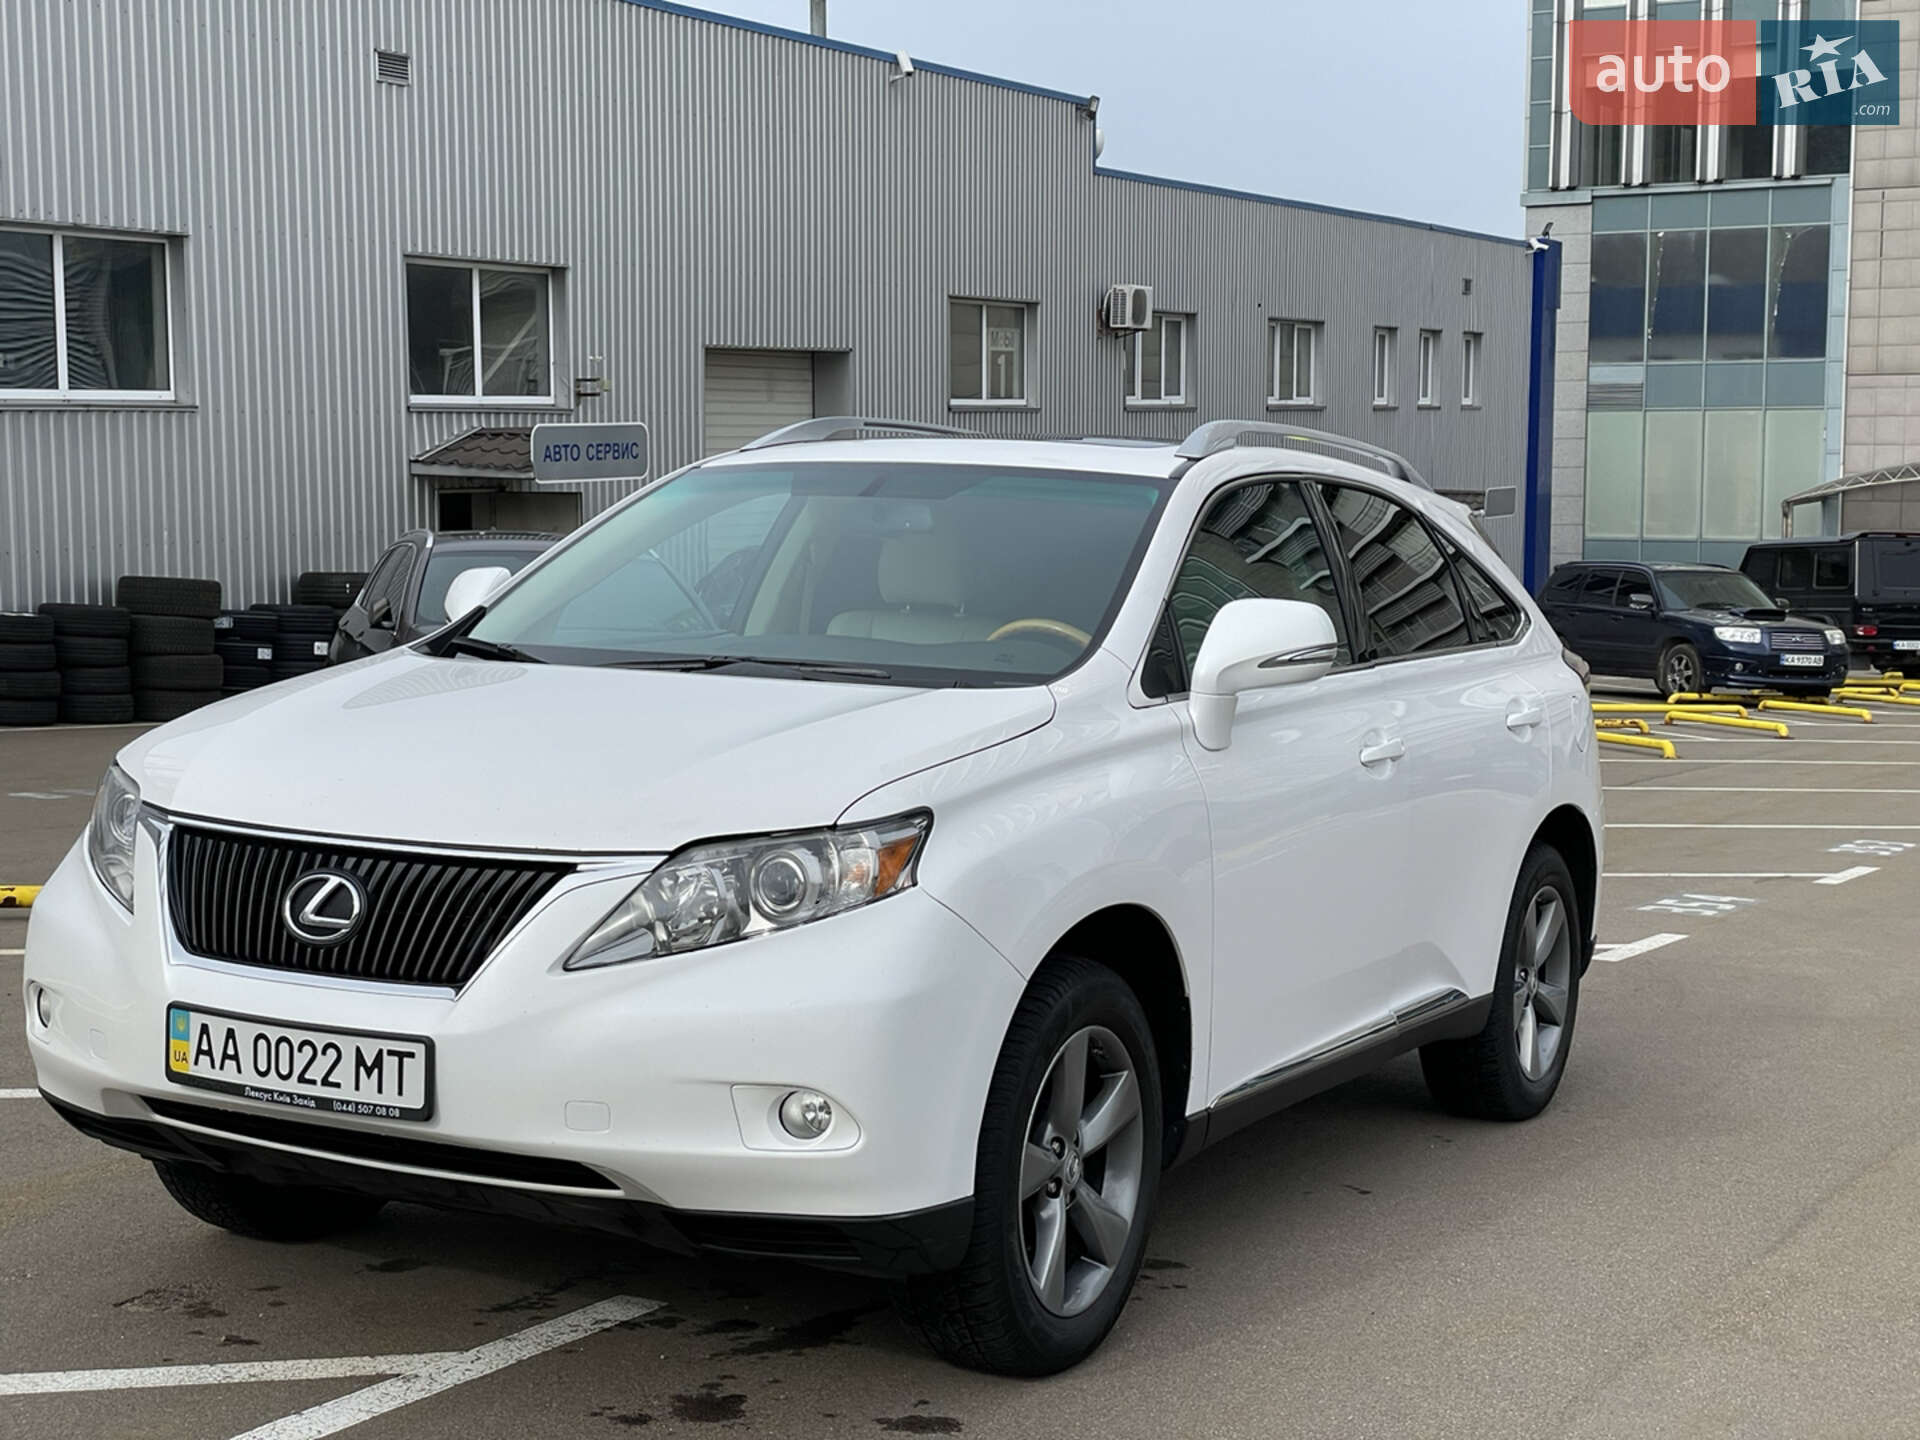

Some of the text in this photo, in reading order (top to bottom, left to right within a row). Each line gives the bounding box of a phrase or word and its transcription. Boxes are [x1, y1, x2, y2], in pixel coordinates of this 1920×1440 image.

[543, 442, 640, 462] АВТО СЕРВИС
[174, 1050, 188, 1064] UA
[194, 1023, 416, 1097] AA 0022 MT
[244, 1086, 272, 1102] Лексус
[333, 1100, 356, 1113] (044)
[357, 1103, 374, 1114] 507
[375, 1106, 387, 1116] 08
[388, 1107, 400, 1118] 08
